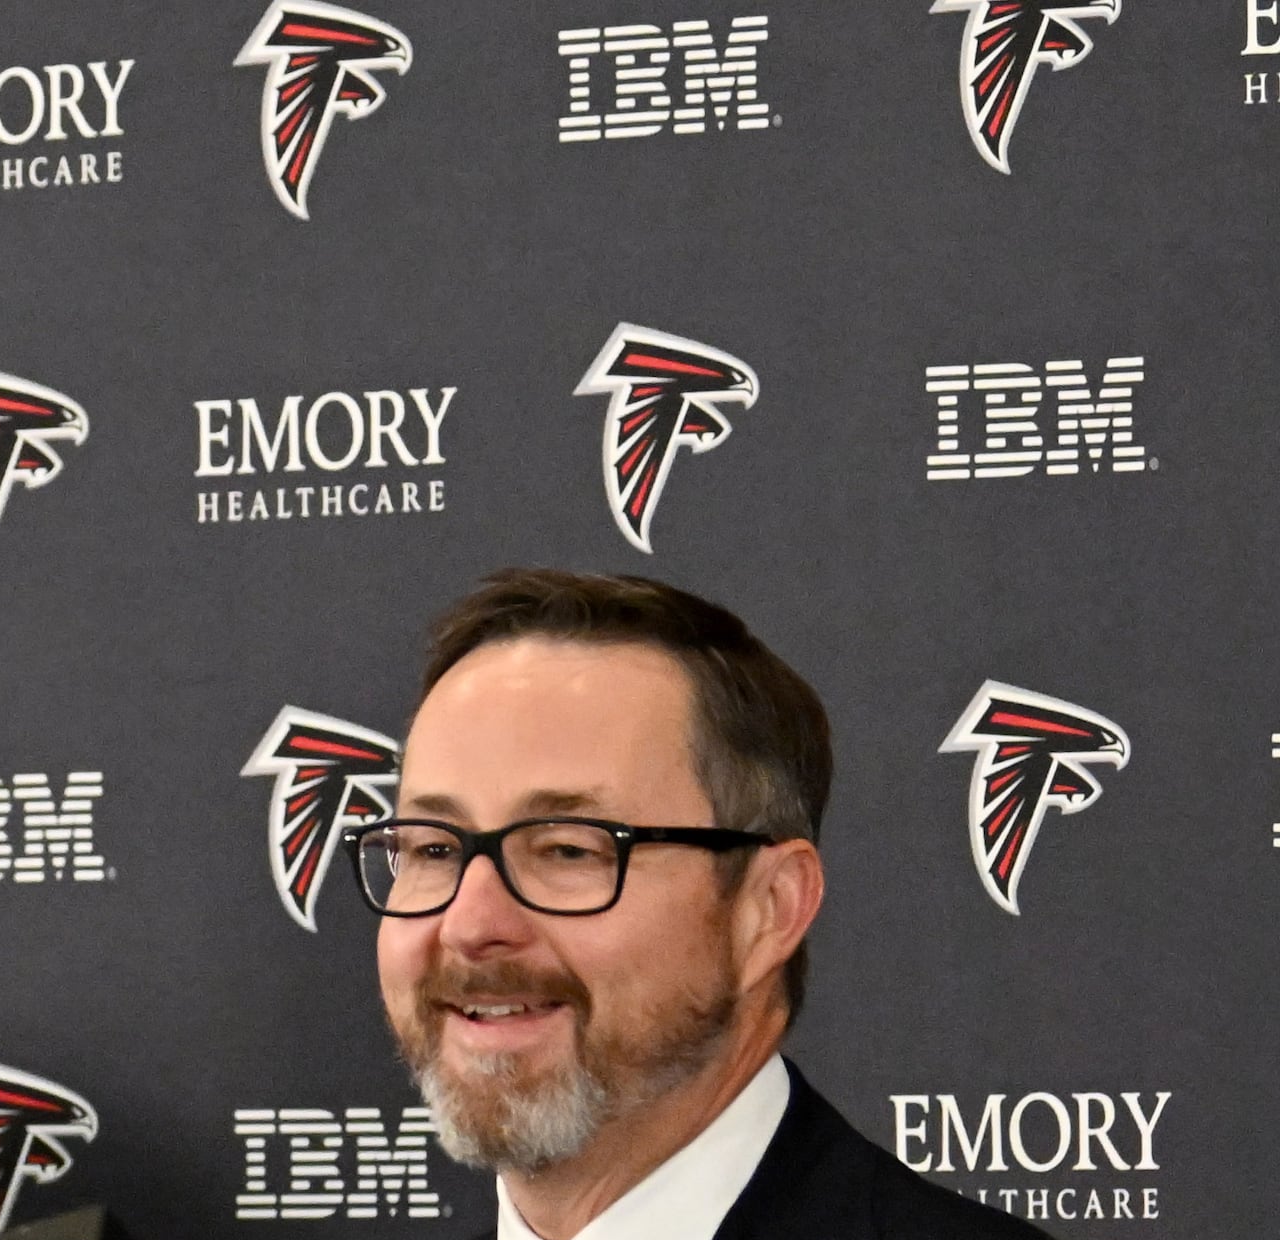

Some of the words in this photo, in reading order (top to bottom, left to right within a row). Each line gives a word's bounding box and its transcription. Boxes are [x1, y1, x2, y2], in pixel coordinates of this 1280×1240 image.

[557, 15, 770, 142] IBM
[193, 386, 458, 477] EMORY
[925, 356, 1146, 481] IBM
[196, 479, 446, 524] HEALTHCARE
[234, 1107, 440, 1219] IBM
[889, 1091, 1172, 1173] EMORY
